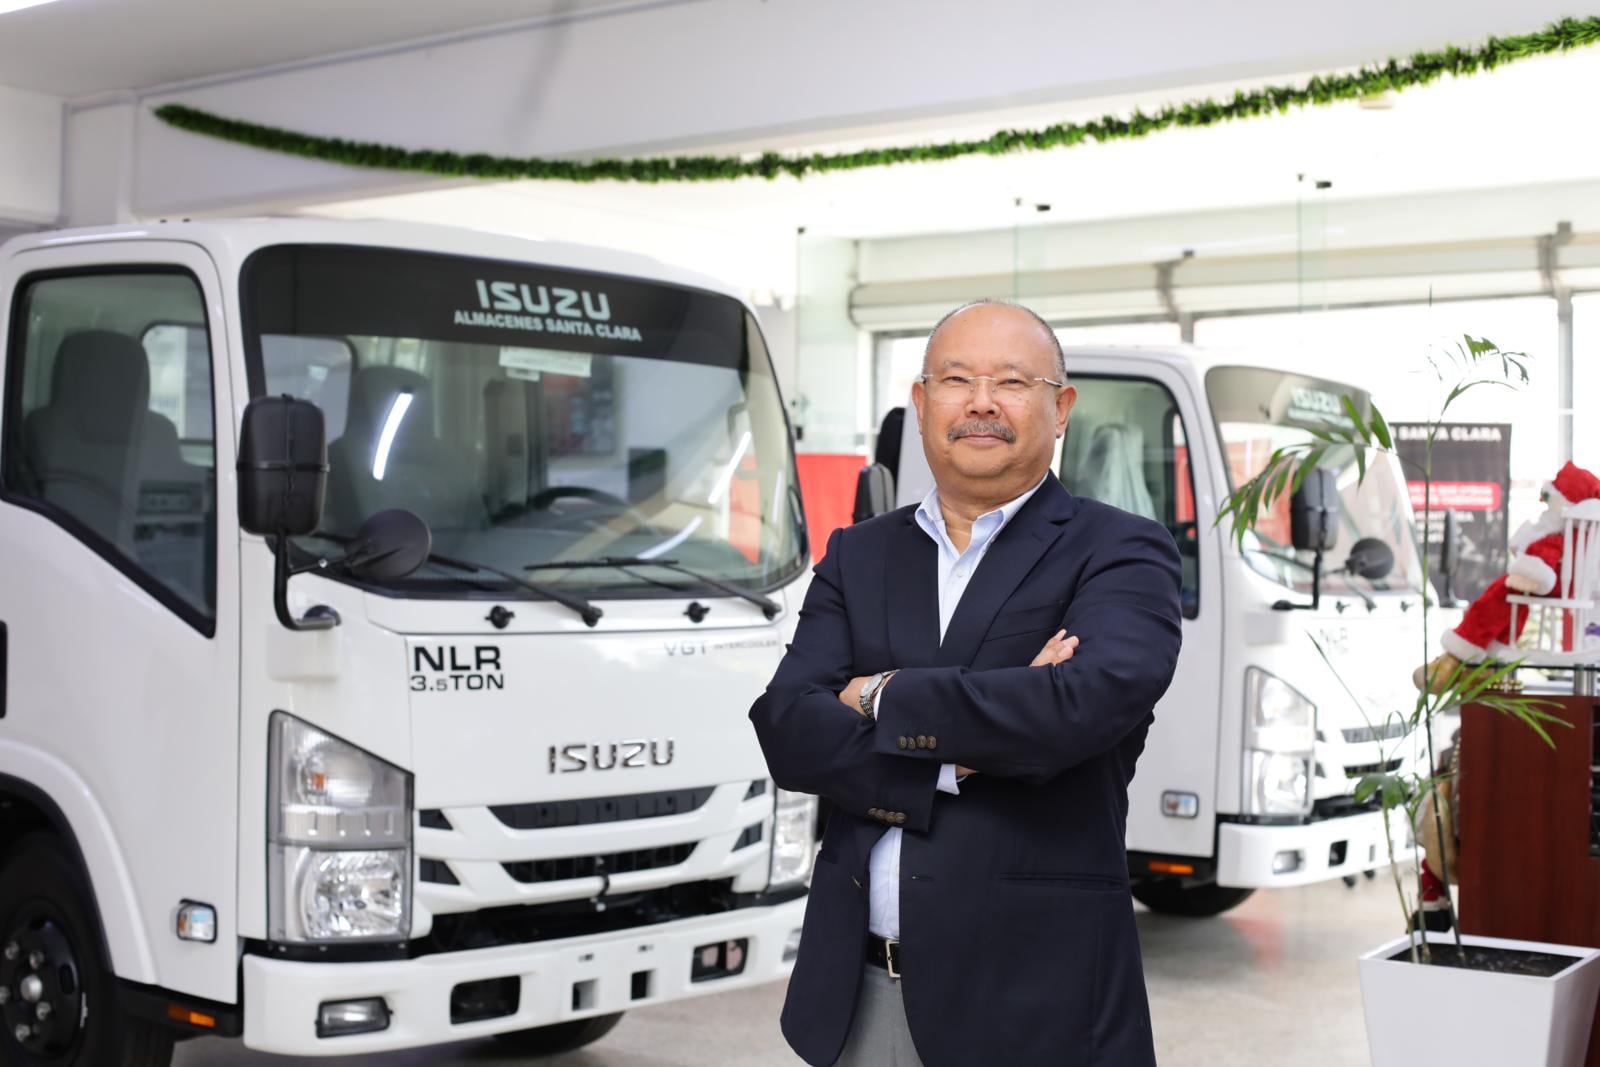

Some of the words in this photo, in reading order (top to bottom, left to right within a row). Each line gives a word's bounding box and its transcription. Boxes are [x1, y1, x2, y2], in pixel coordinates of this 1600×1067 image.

[476, 279, 611, 321] ISUZU
[454, 310, 543, 332] ALMACENES
[546, 318, 595, 337] SANTA
[596, 323, 642, 342] CLARA
[1450, 426, 1502, 442] CLARA
[713, 639, 777, 650] INTERCOOLER
[414, 646, 501, 672] NLR
[410, 673, 504, 692] 3.5TON
[548, 738, 674, 774] ISUZU
